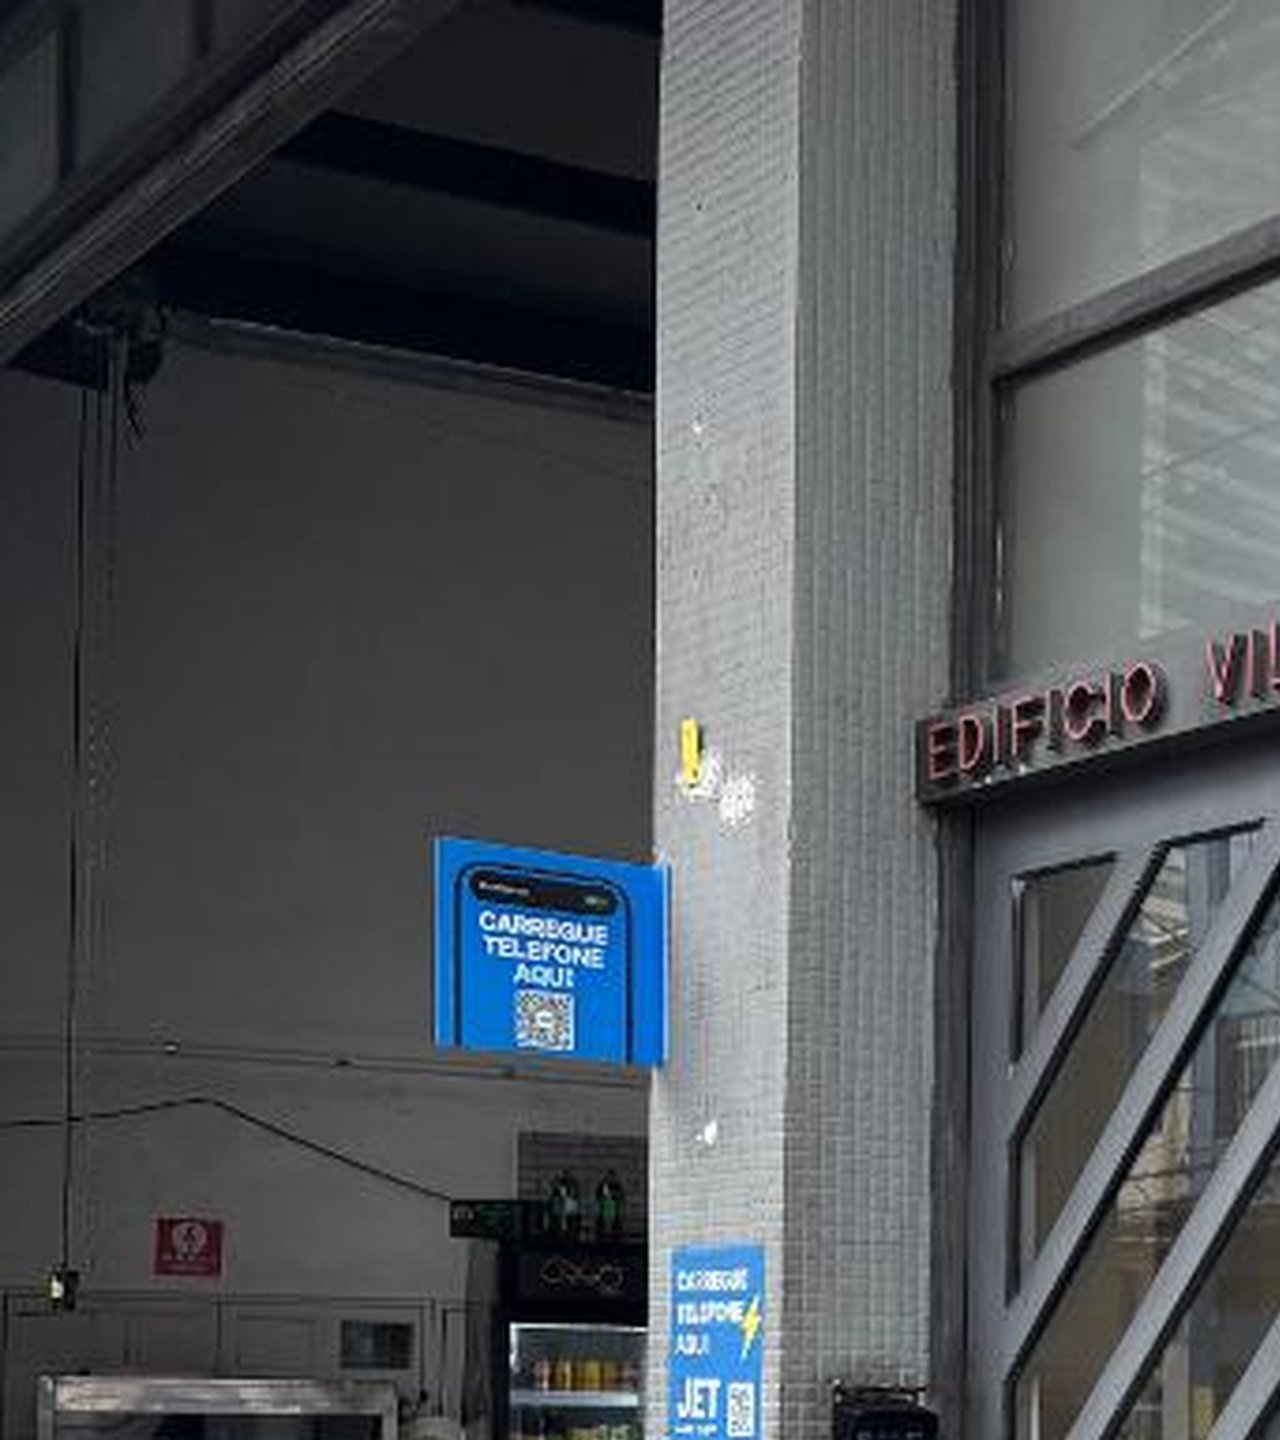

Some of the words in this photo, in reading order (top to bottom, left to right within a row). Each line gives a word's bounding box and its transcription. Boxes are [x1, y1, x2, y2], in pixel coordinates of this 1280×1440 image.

[927, 661, 1160, 782] EDIFICIO
[478, 909, 609, 948] CARREGUE
[482, 934, 606, 970] TELEFONE
[512, 962, 575, 988] AQUI
[677, 1376, 722, 1420] JET
